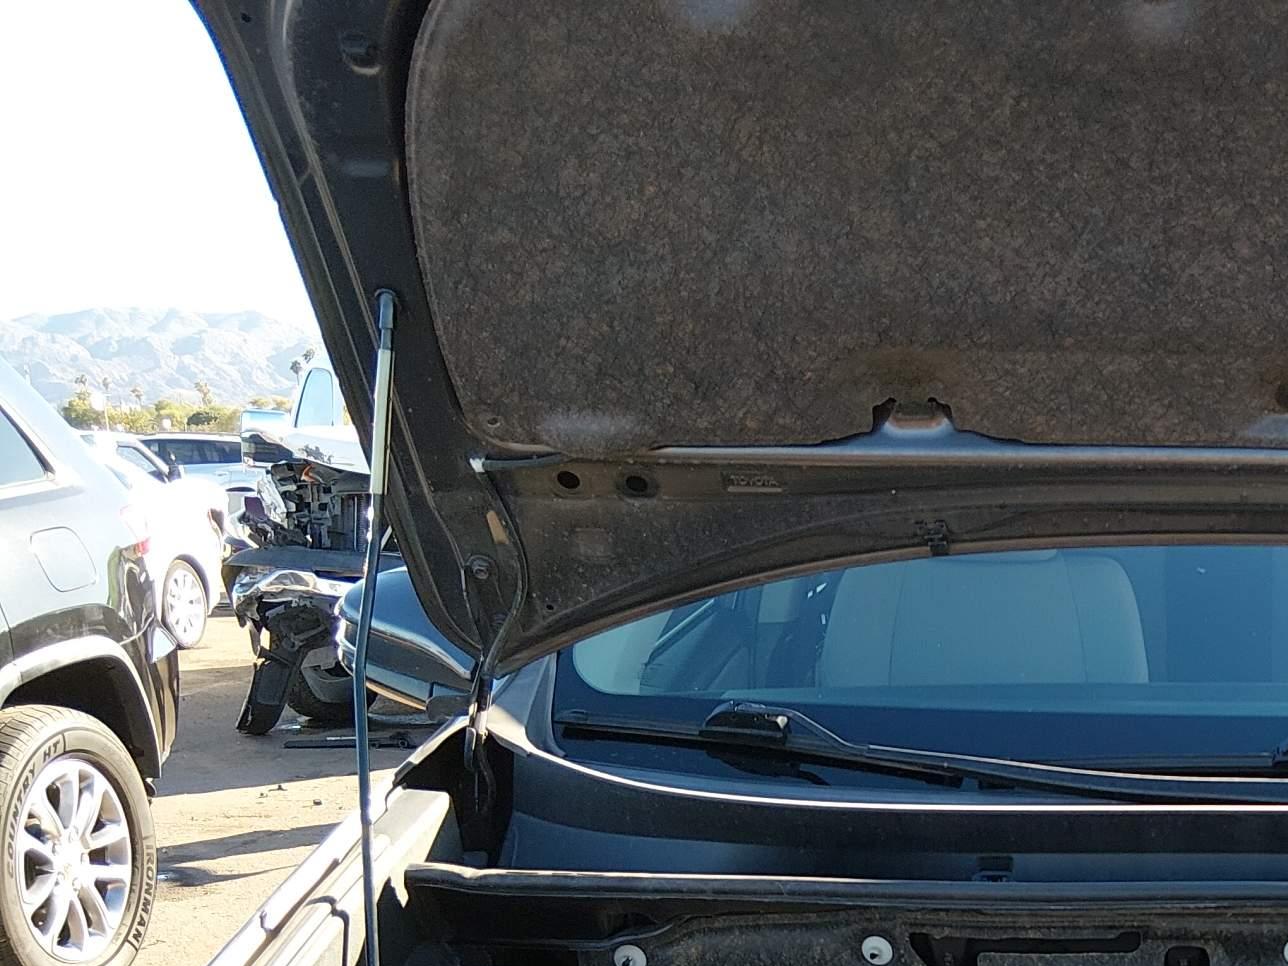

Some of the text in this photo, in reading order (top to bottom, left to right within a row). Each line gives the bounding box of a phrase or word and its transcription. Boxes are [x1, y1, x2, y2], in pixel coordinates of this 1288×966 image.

[7, 739, 60, 879] COUNTRY HT
[132, 844, 156, 948] IRONMAN
